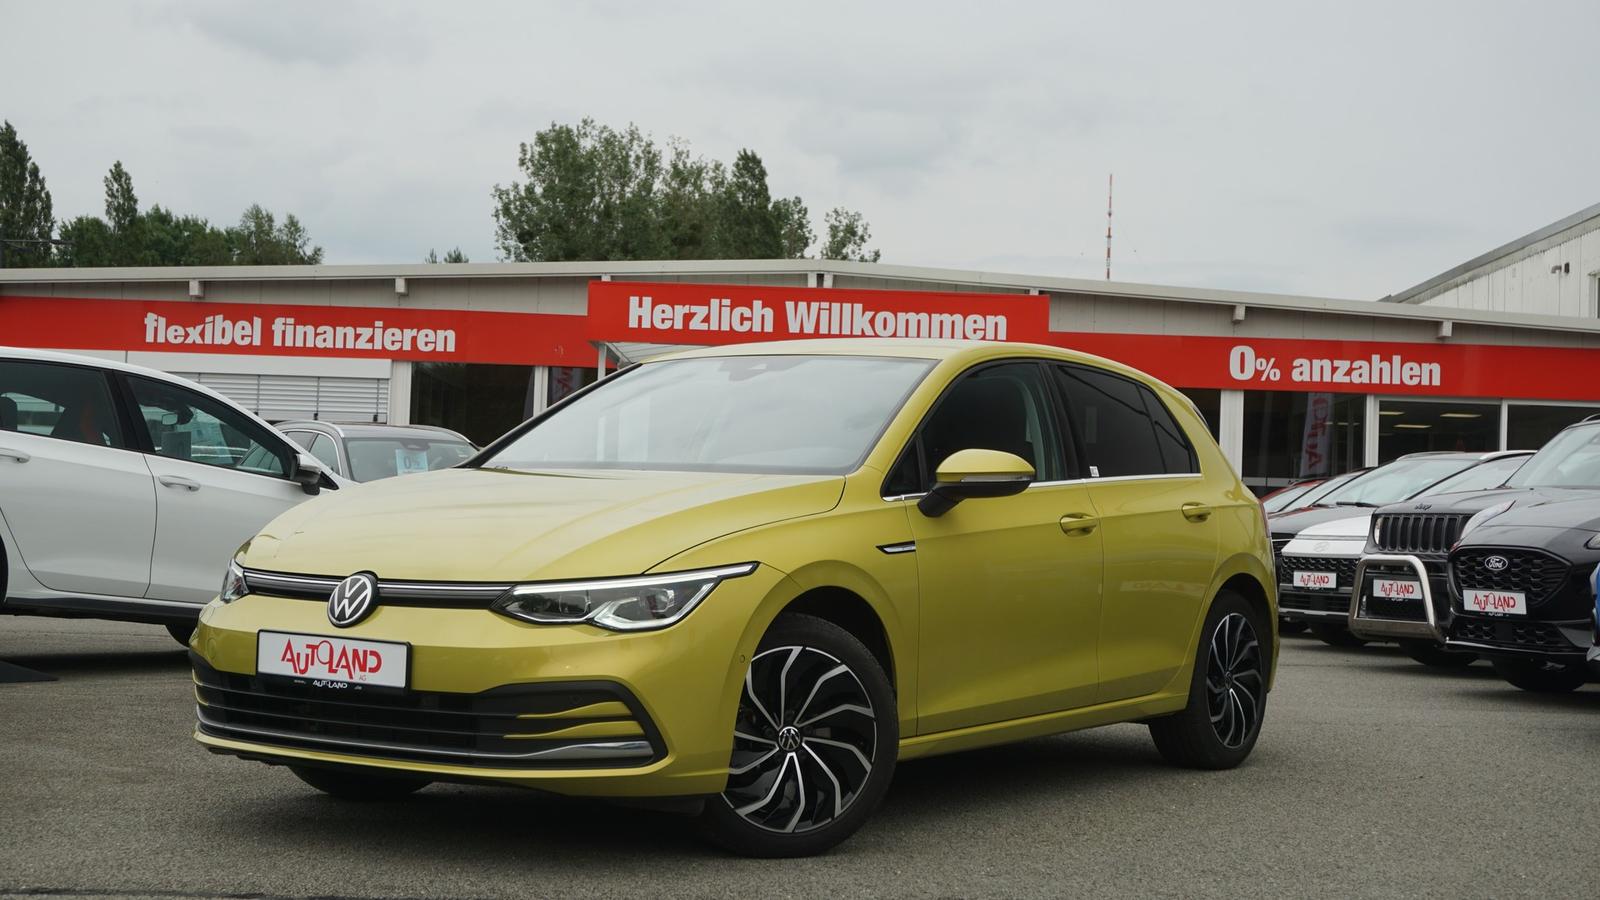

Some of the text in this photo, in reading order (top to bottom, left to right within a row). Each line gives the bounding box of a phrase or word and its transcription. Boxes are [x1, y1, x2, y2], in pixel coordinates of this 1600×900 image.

[144, 312, 457, 352] flexibel finanzieren
[628, 296, 1008, 341] Herzlich Willkommen
[1229, 345, 1441, 386] 0% anzahlen
[1487, 557, 1504, 569] Ford
[1380, 582, 1415, 597] AUTOLAND
[1473, 592, 1516, 611] AUTOLAND
[281, 638, 383, 680] AUTOLAND
